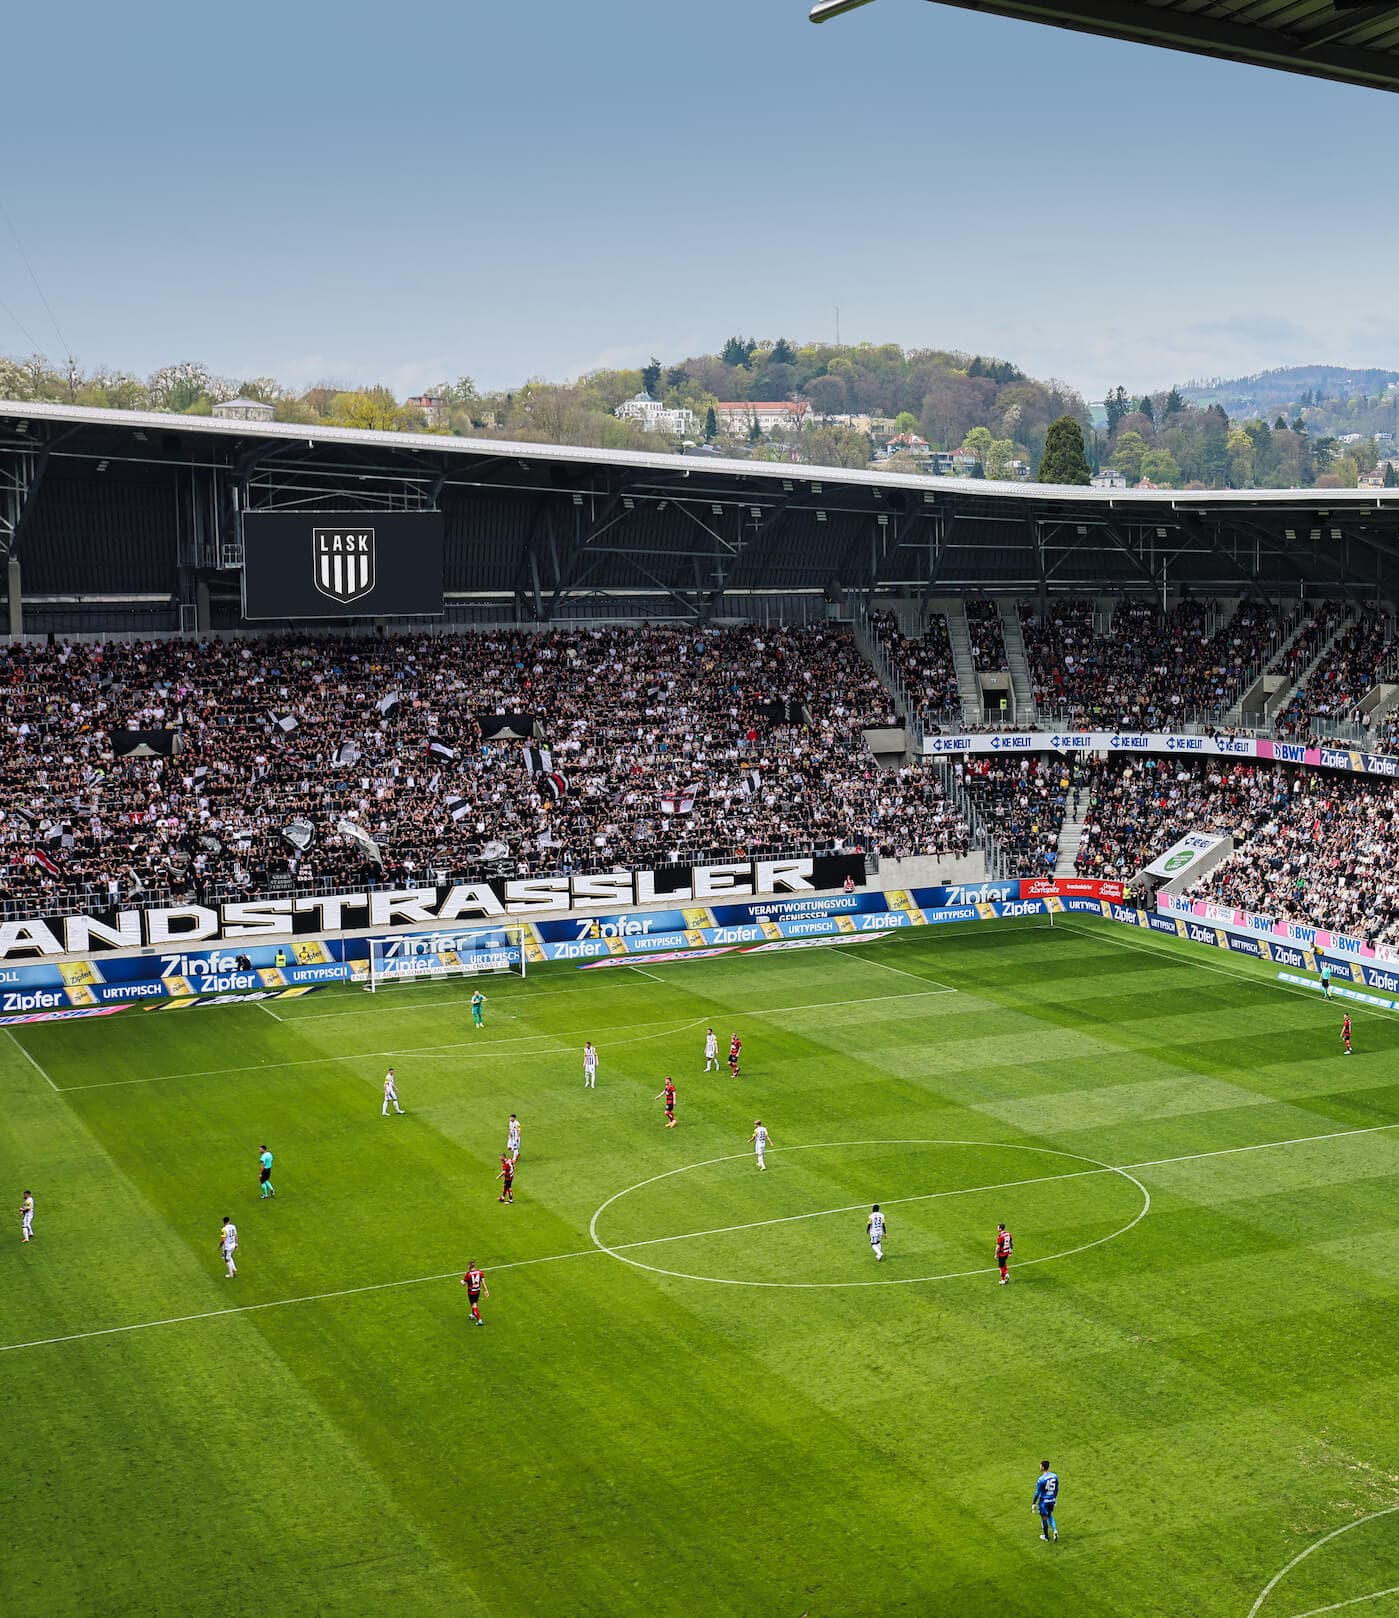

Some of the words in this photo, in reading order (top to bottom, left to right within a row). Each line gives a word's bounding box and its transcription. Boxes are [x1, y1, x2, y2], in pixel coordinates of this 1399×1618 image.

[320, 535, 369, 551] LASK
[1282, 745, 1306, 763] BWT
[1321, 751, 1349, 768] Zipfer
[1368, 757, 1397, 776] Zipfer
[945, 883, 1011, 907] Zipfer
[748, 897, 857, 917] VERANTWORTUNGSVOLL
[932, 908, 974, 921] URTYPISCH
[1002, 900, 1042, 916] Zipfer
[1069, 901, 1101, 913] URTYPISCH
[1114, 905, 1136, 924] Zipfer
[788, 922, 832, 934] URTYPISCH
[862, 914, 904, 930] Zipfer
[713, 928, 758, 944] Zipfer
[1190, 924, 1215, 944] Zipfer
[1295, 927, 1317, 943] BWT
[554, 942, 601, 959] Zipfer
[634, 936, 682, 950] URTYPISCH
[1338, 936, 1361, 954] BWT
[160, 951, 249, 978] Zipfe
[470, 950, 520, 964] URTYPISCH
[1275, 946, 1302, 967] Zipfer
[293, 966, 348, 981] URTYPISCH
[1368, 970, 1399, 991] Zipfer
[102, 984, 162, 999] URTYPISCH
[201, 974, 256, 993] Zipfer
[3, 992, 62, 1011] Zipfer
